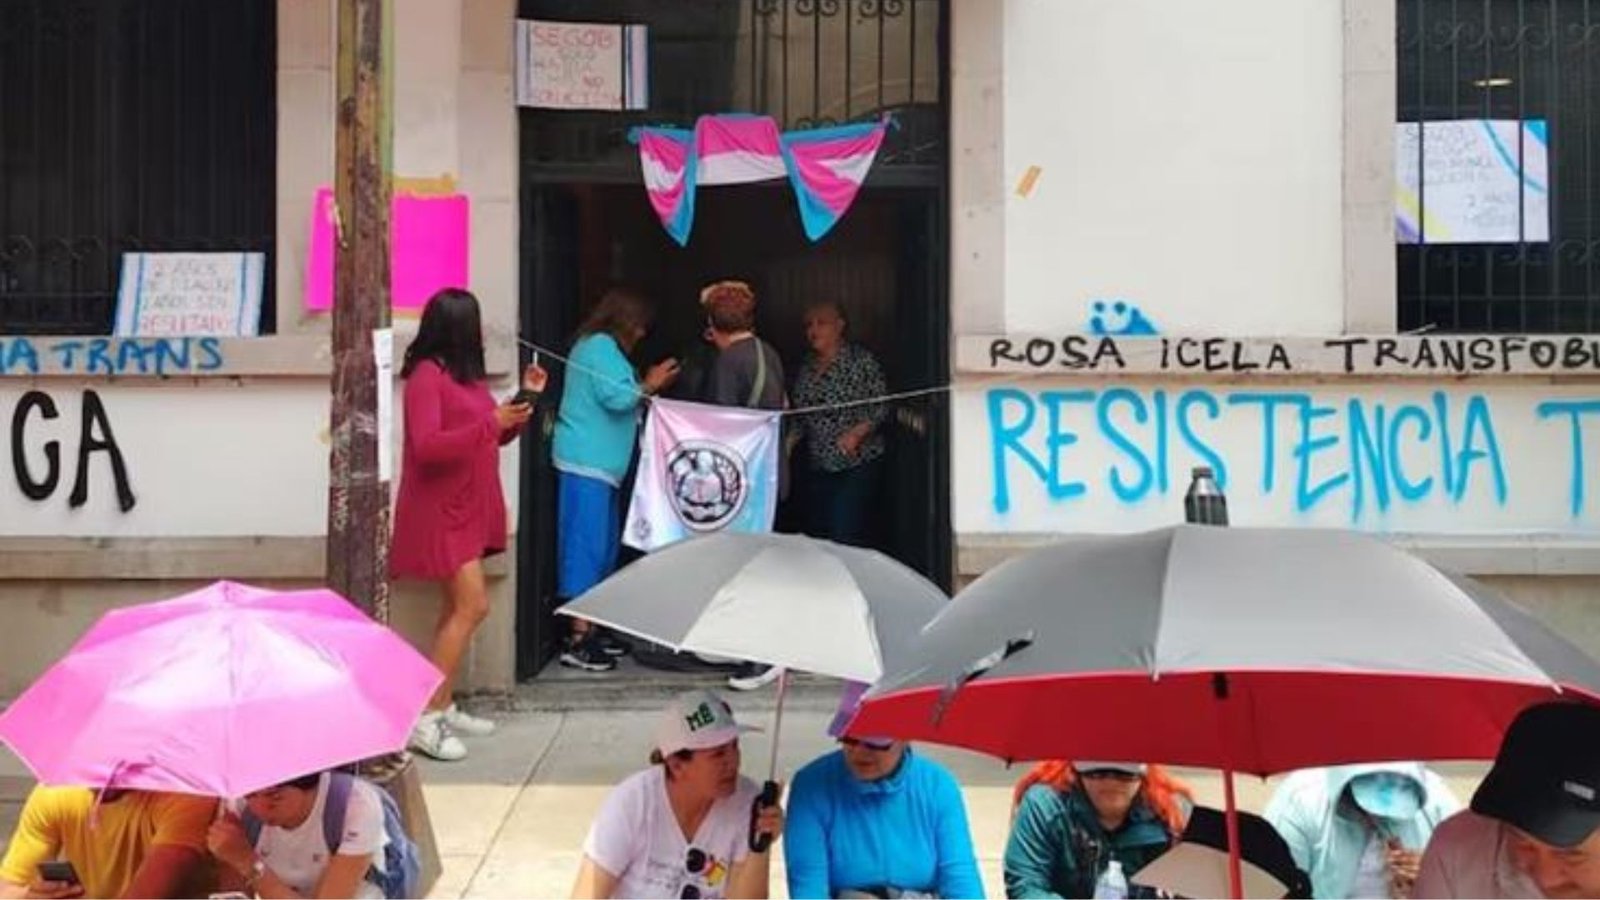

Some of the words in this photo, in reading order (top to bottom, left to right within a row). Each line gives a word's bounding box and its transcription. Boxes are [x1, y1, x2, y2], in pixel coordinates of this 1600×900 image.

[532, 26, 614, 49] SEGOB
[53, 337, 223, 377] TRANS
[990, 336, 1126, 369] ROSA
[1160, 337, 1292, 371] ICELA
[986, 387, 1507, 523] RESISTENCIA
